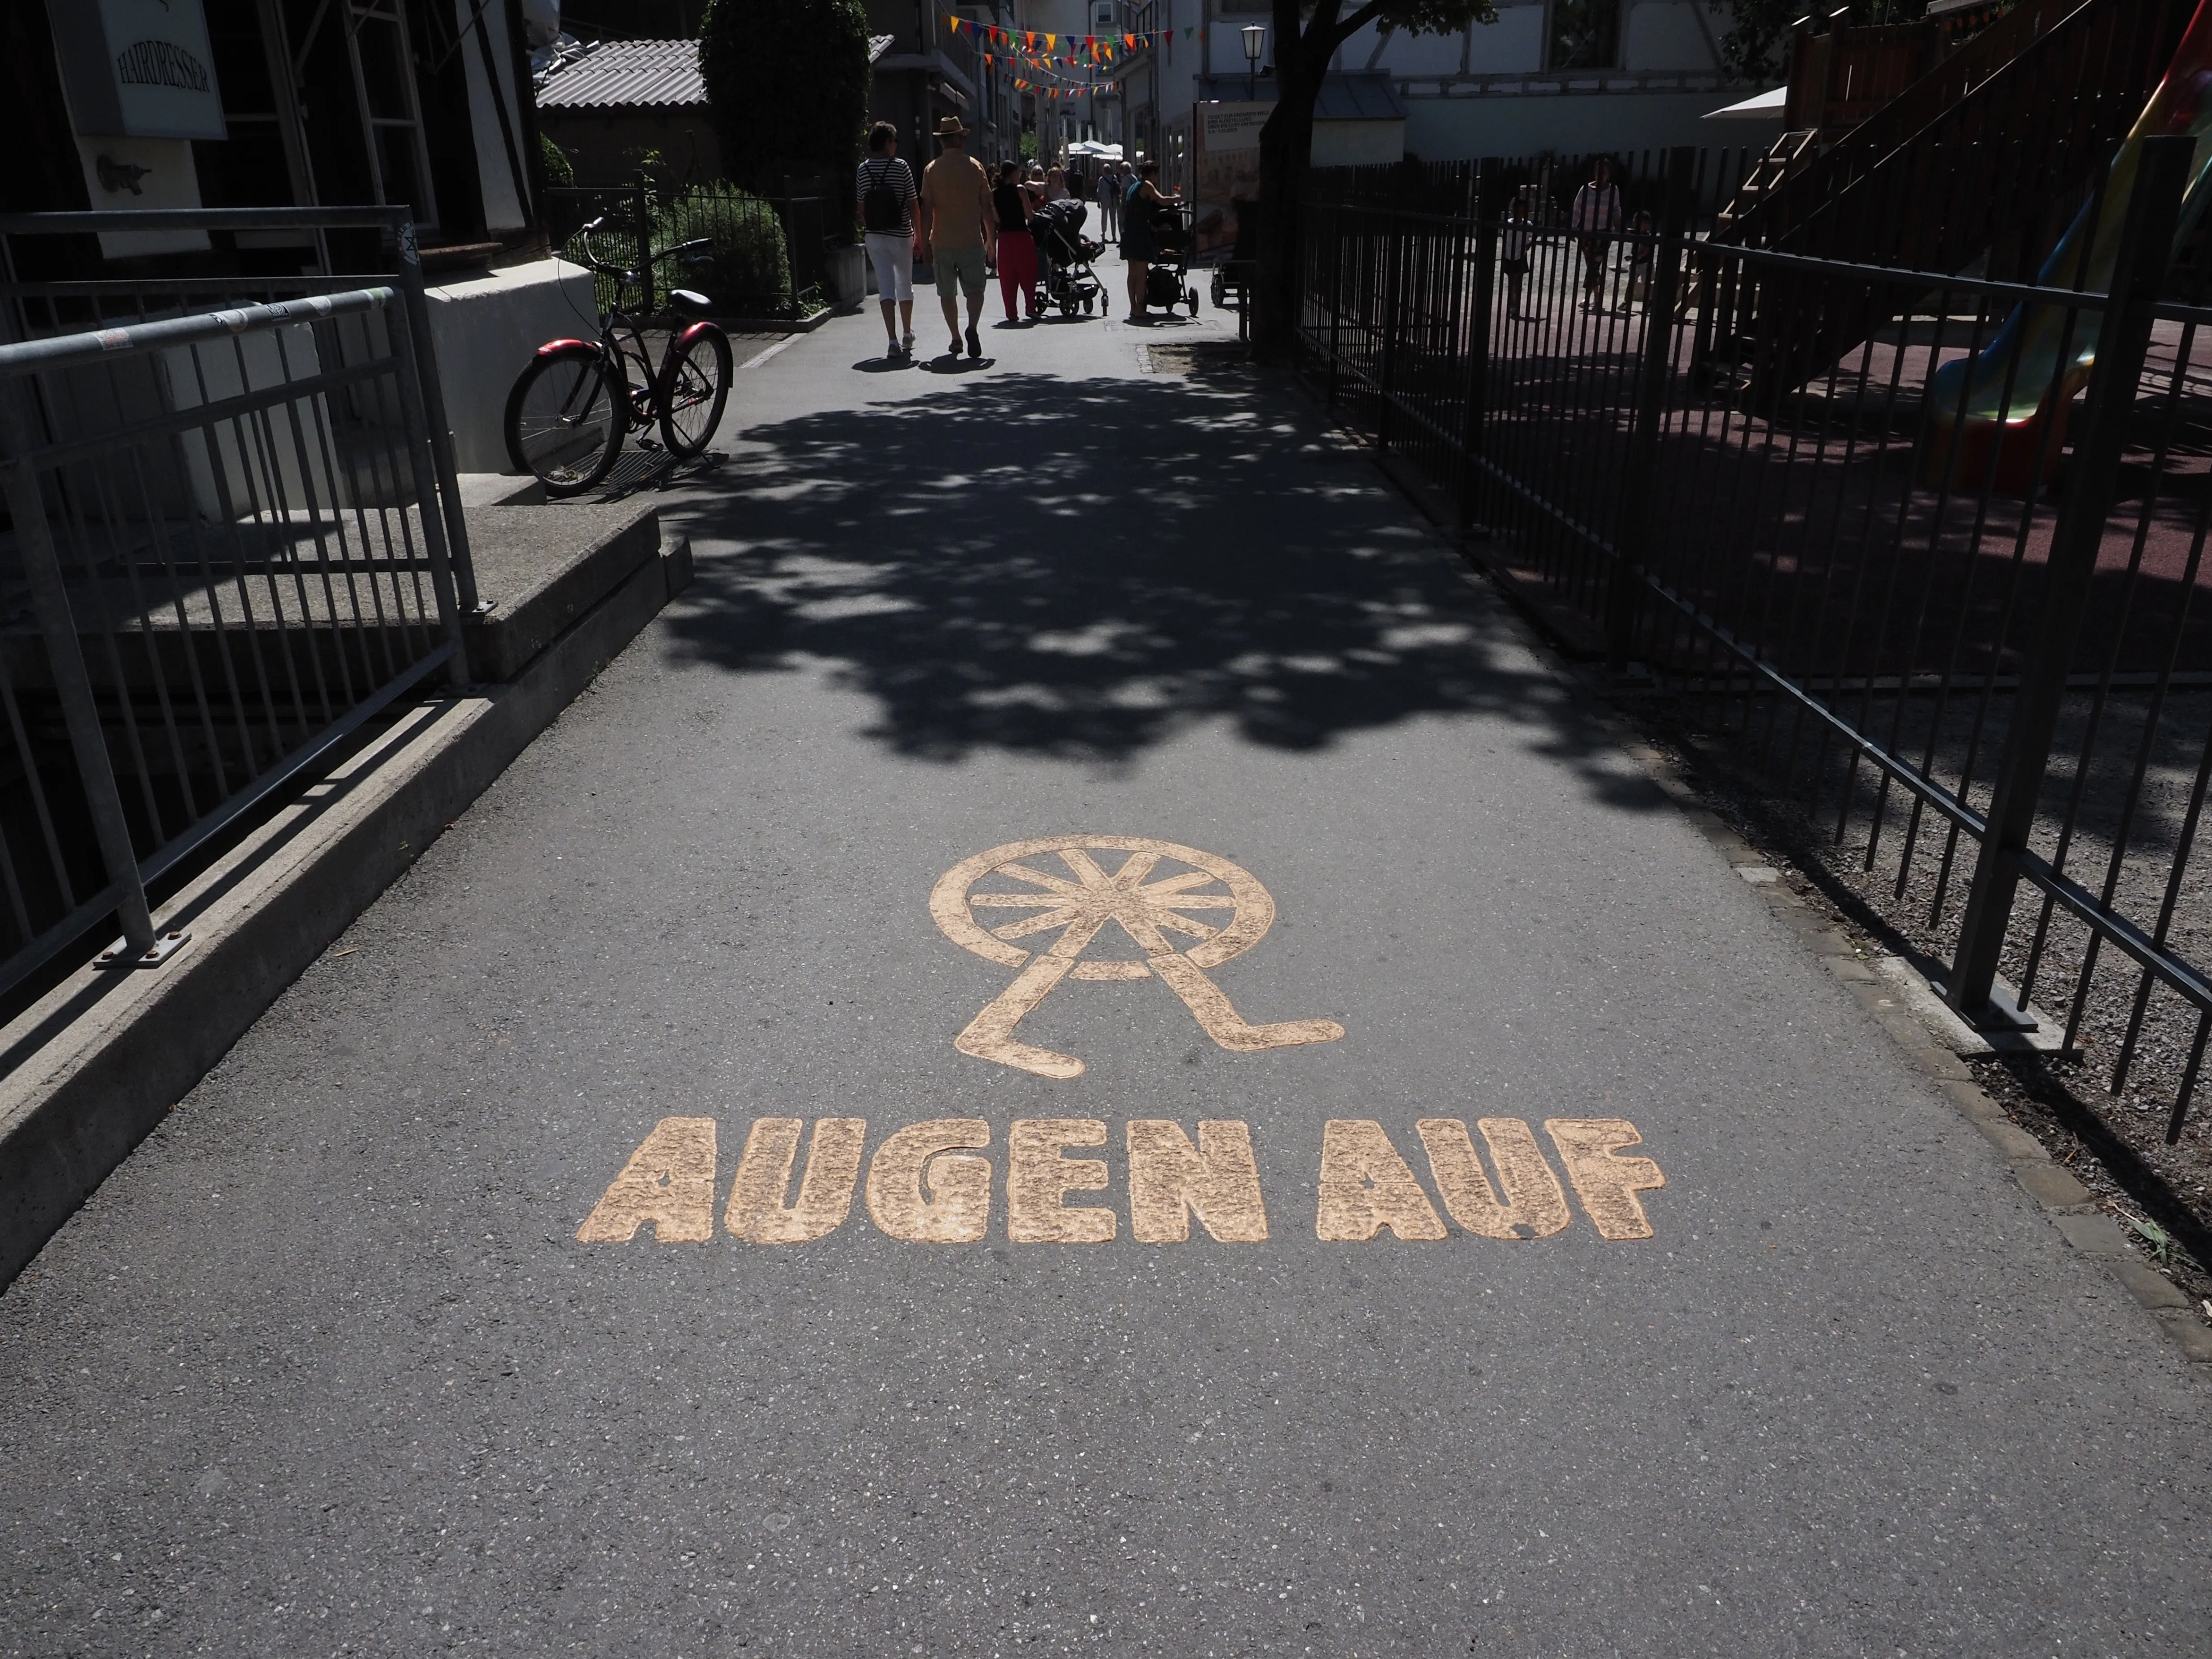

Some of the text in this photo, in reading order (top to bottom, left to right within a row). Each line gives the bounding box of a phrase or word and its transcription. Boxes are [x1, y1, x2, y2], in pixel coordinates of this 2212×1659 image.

[117, 41, 210, 93] HAIRDRESSER
[575, 1117, 1667, 1244] AUGEN AUF
